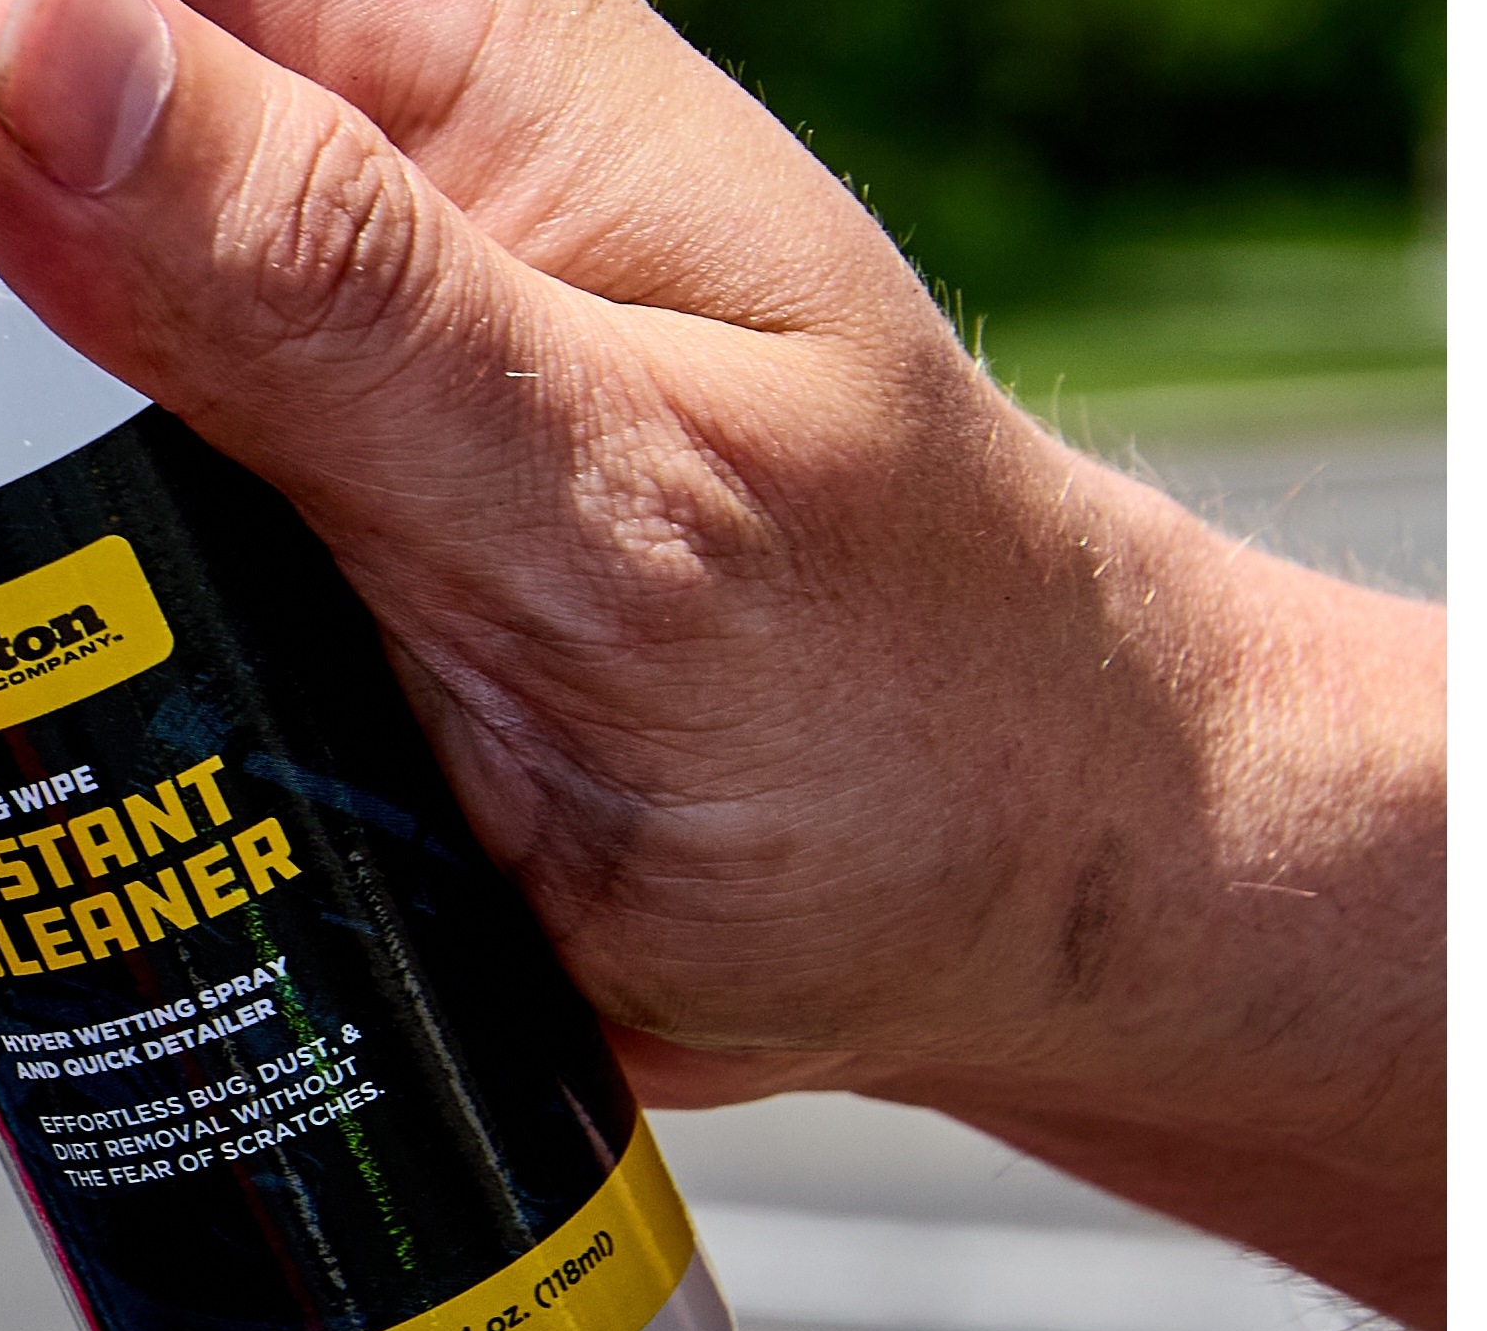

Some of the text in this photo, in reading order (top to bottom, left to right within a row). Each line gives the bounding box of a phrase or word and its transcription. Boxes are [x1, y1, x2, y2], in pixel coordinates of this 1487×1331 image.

[9, 765, 99, 812] WIPE
[0, 956, 287, 1053] HYPER WETTING SPRAY
[16, 999, 277, 1080] AND QUICK DETAILER
[39, 1023, 362, 1134] EFFORTLESS BUG, DUST, &
[51, 1056, 357, 1161] DIRT REMOVAL WITHOUT
[64, 1081, 386, 1187] THE FEAR OF SCRATCHES.
[534, 1230, 614, 1308] (118ml)
